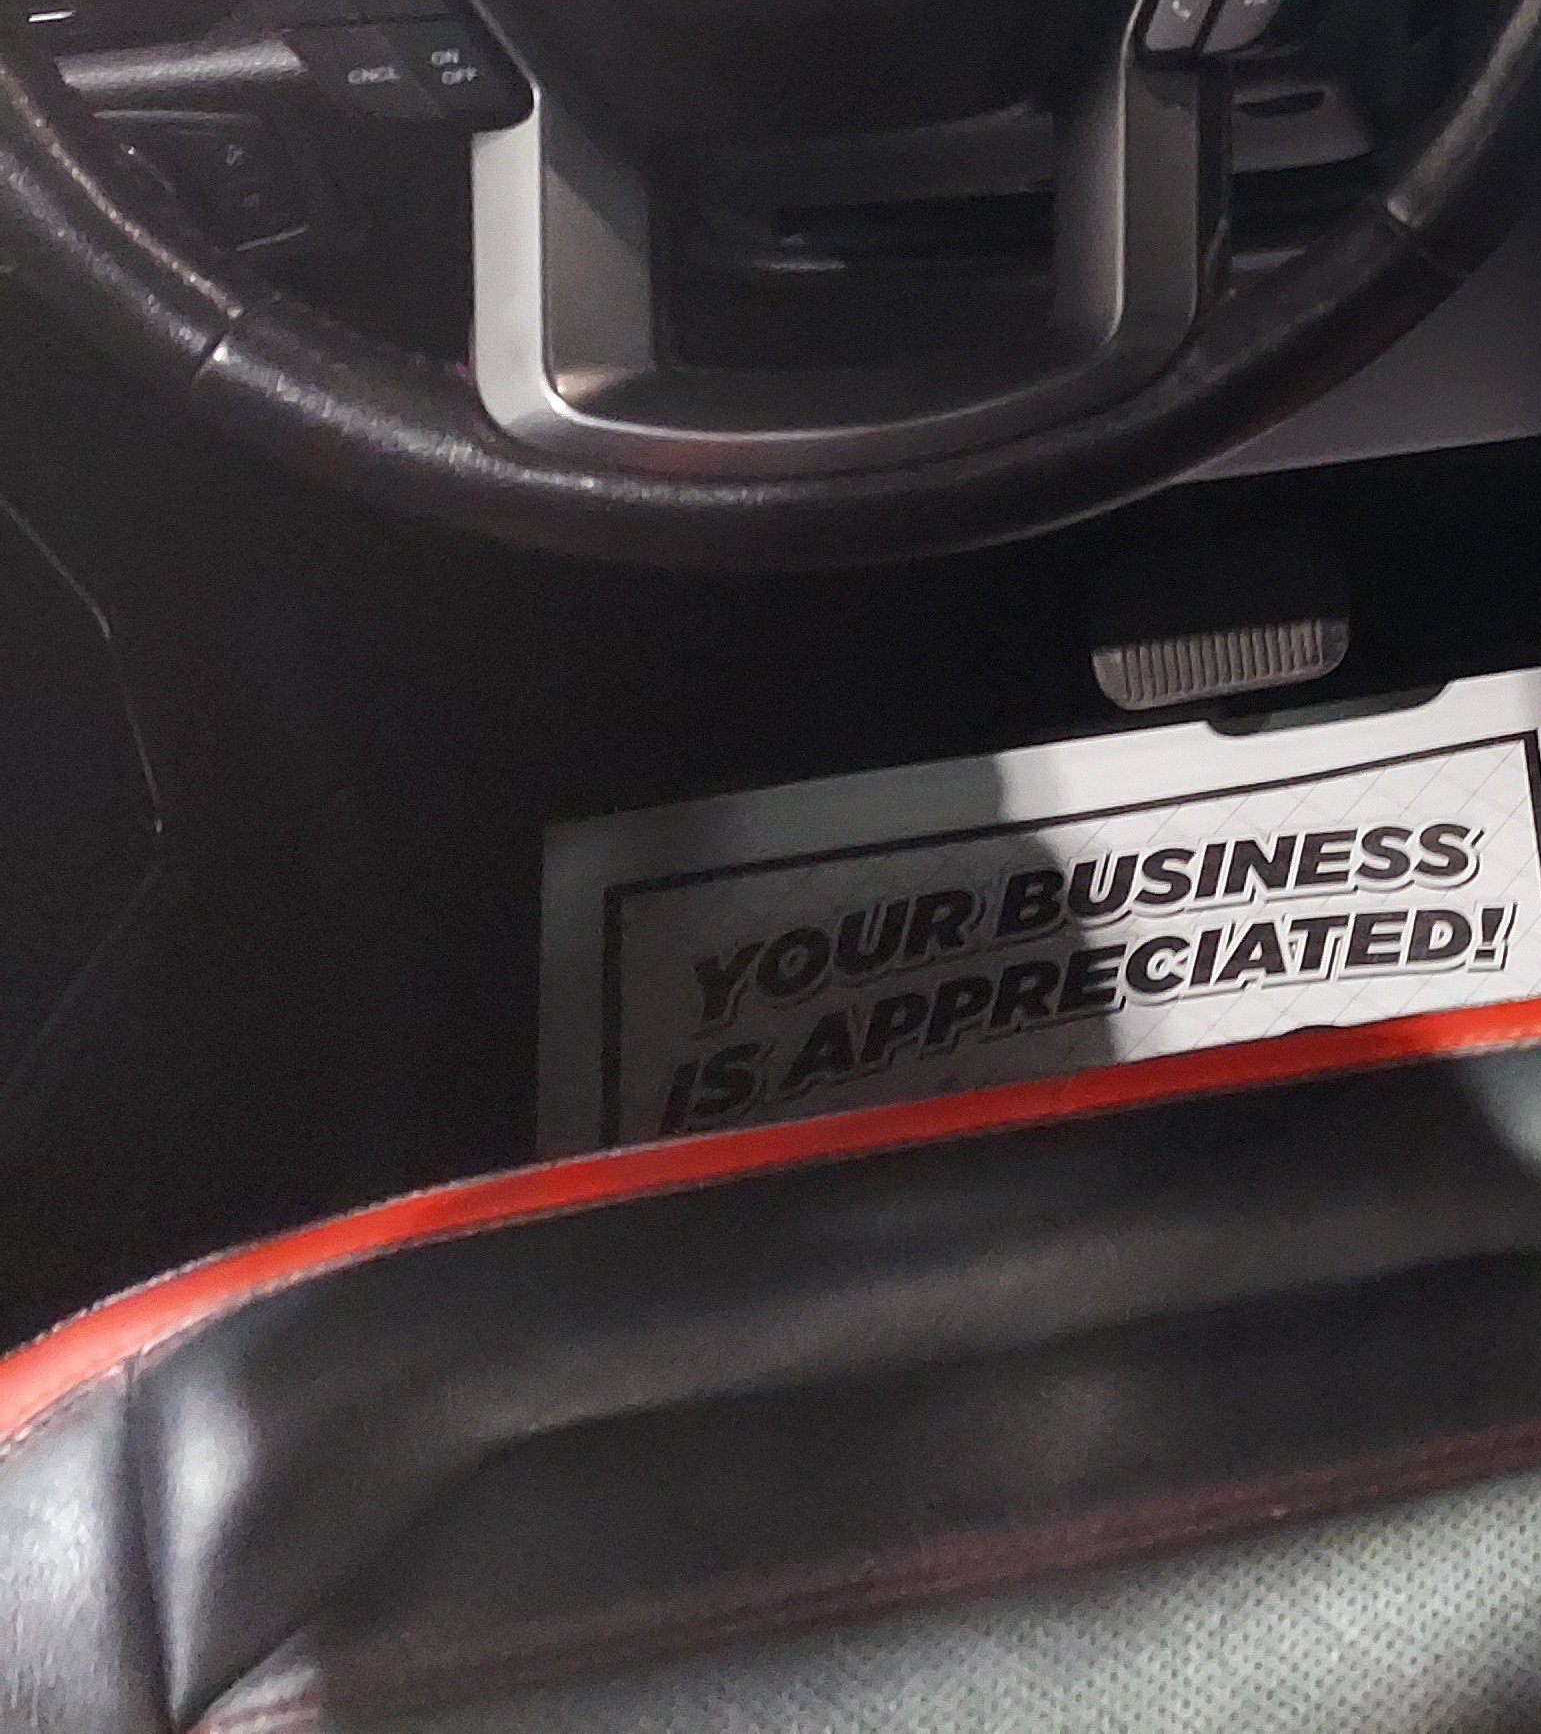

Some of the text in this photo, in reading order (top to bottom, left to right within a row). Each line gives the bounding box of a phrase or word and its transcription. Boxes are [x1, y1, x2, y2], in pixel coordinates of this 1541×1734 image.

[664, 901, 1516, 1138] IS APPRECIATED!
[692, 823, 1486, 1023] YOUR BUSINESS
